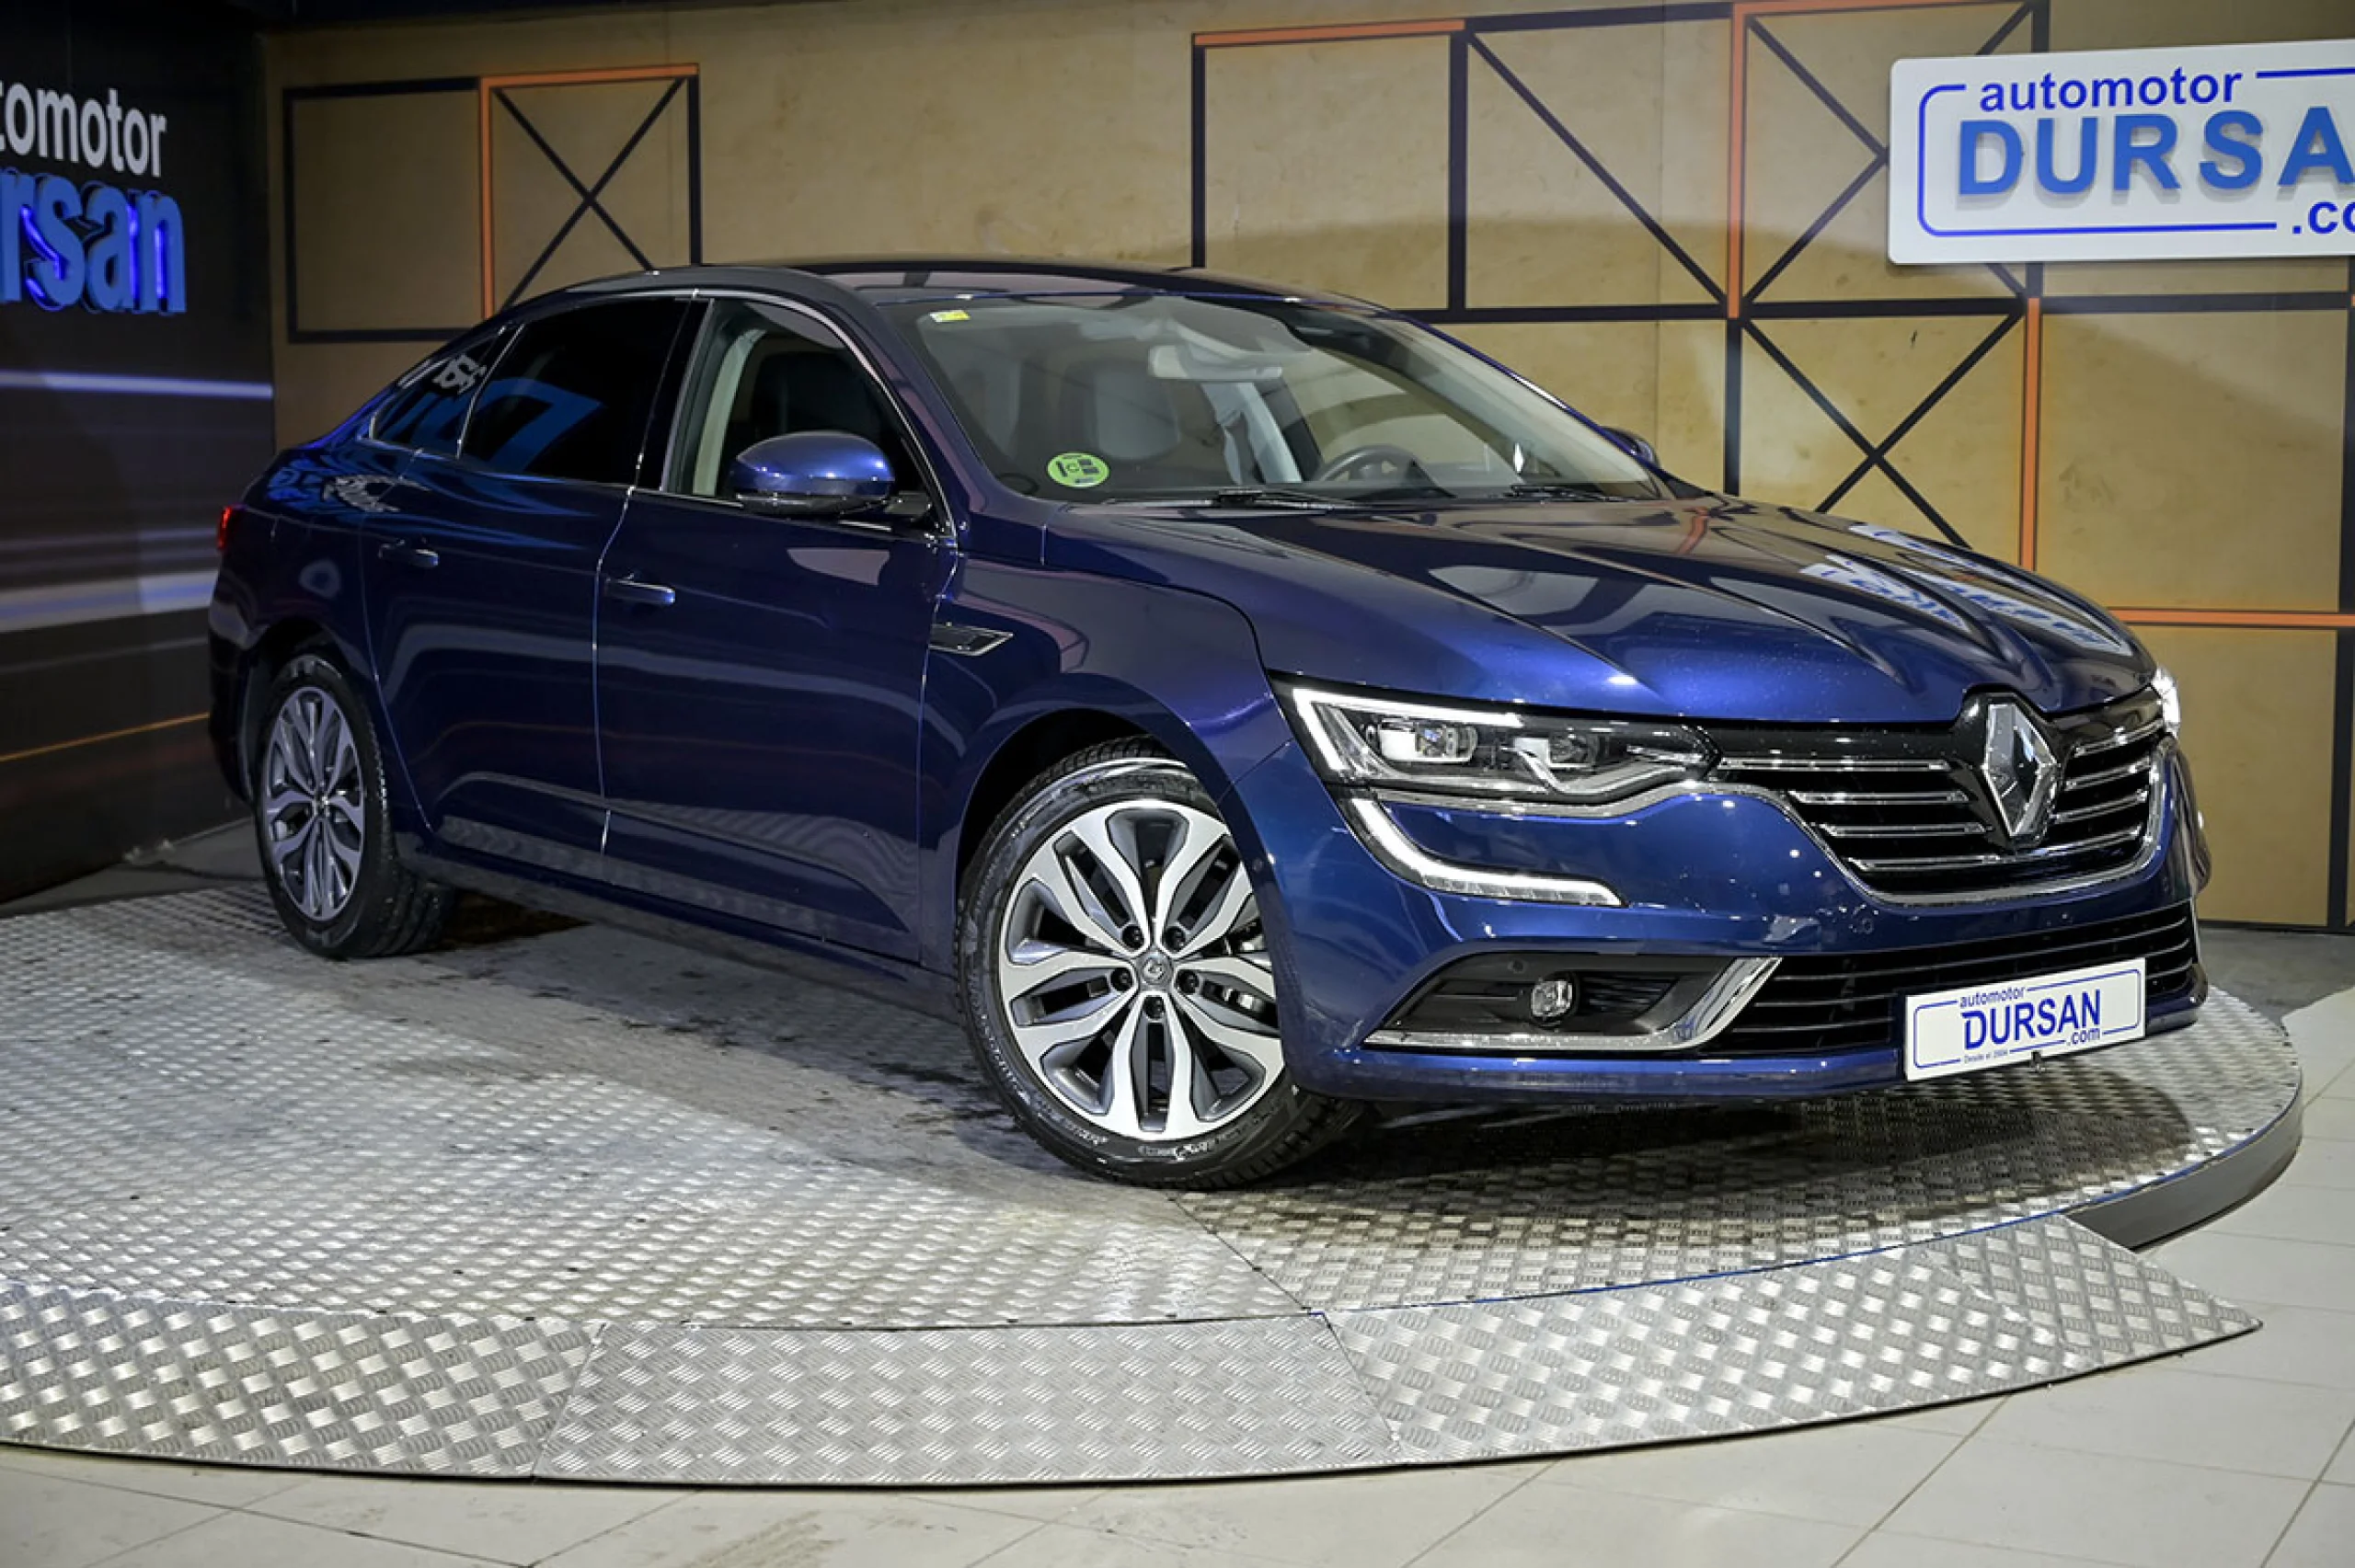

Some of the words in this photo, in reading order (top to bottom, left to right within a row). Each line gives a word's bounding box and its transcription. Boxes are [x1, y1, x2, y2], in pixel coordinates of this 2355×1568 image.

[1980, 66, 2244, 112] automotor
[0, 80, 167, 177] omotor
[1959, 106, 2355, 196] DURSA
[1960, 987, 2026, 1008] automotor
[1960, 989, 2101, 1050] DURSAN
[2066, 1027, 2101, 1047] .com
